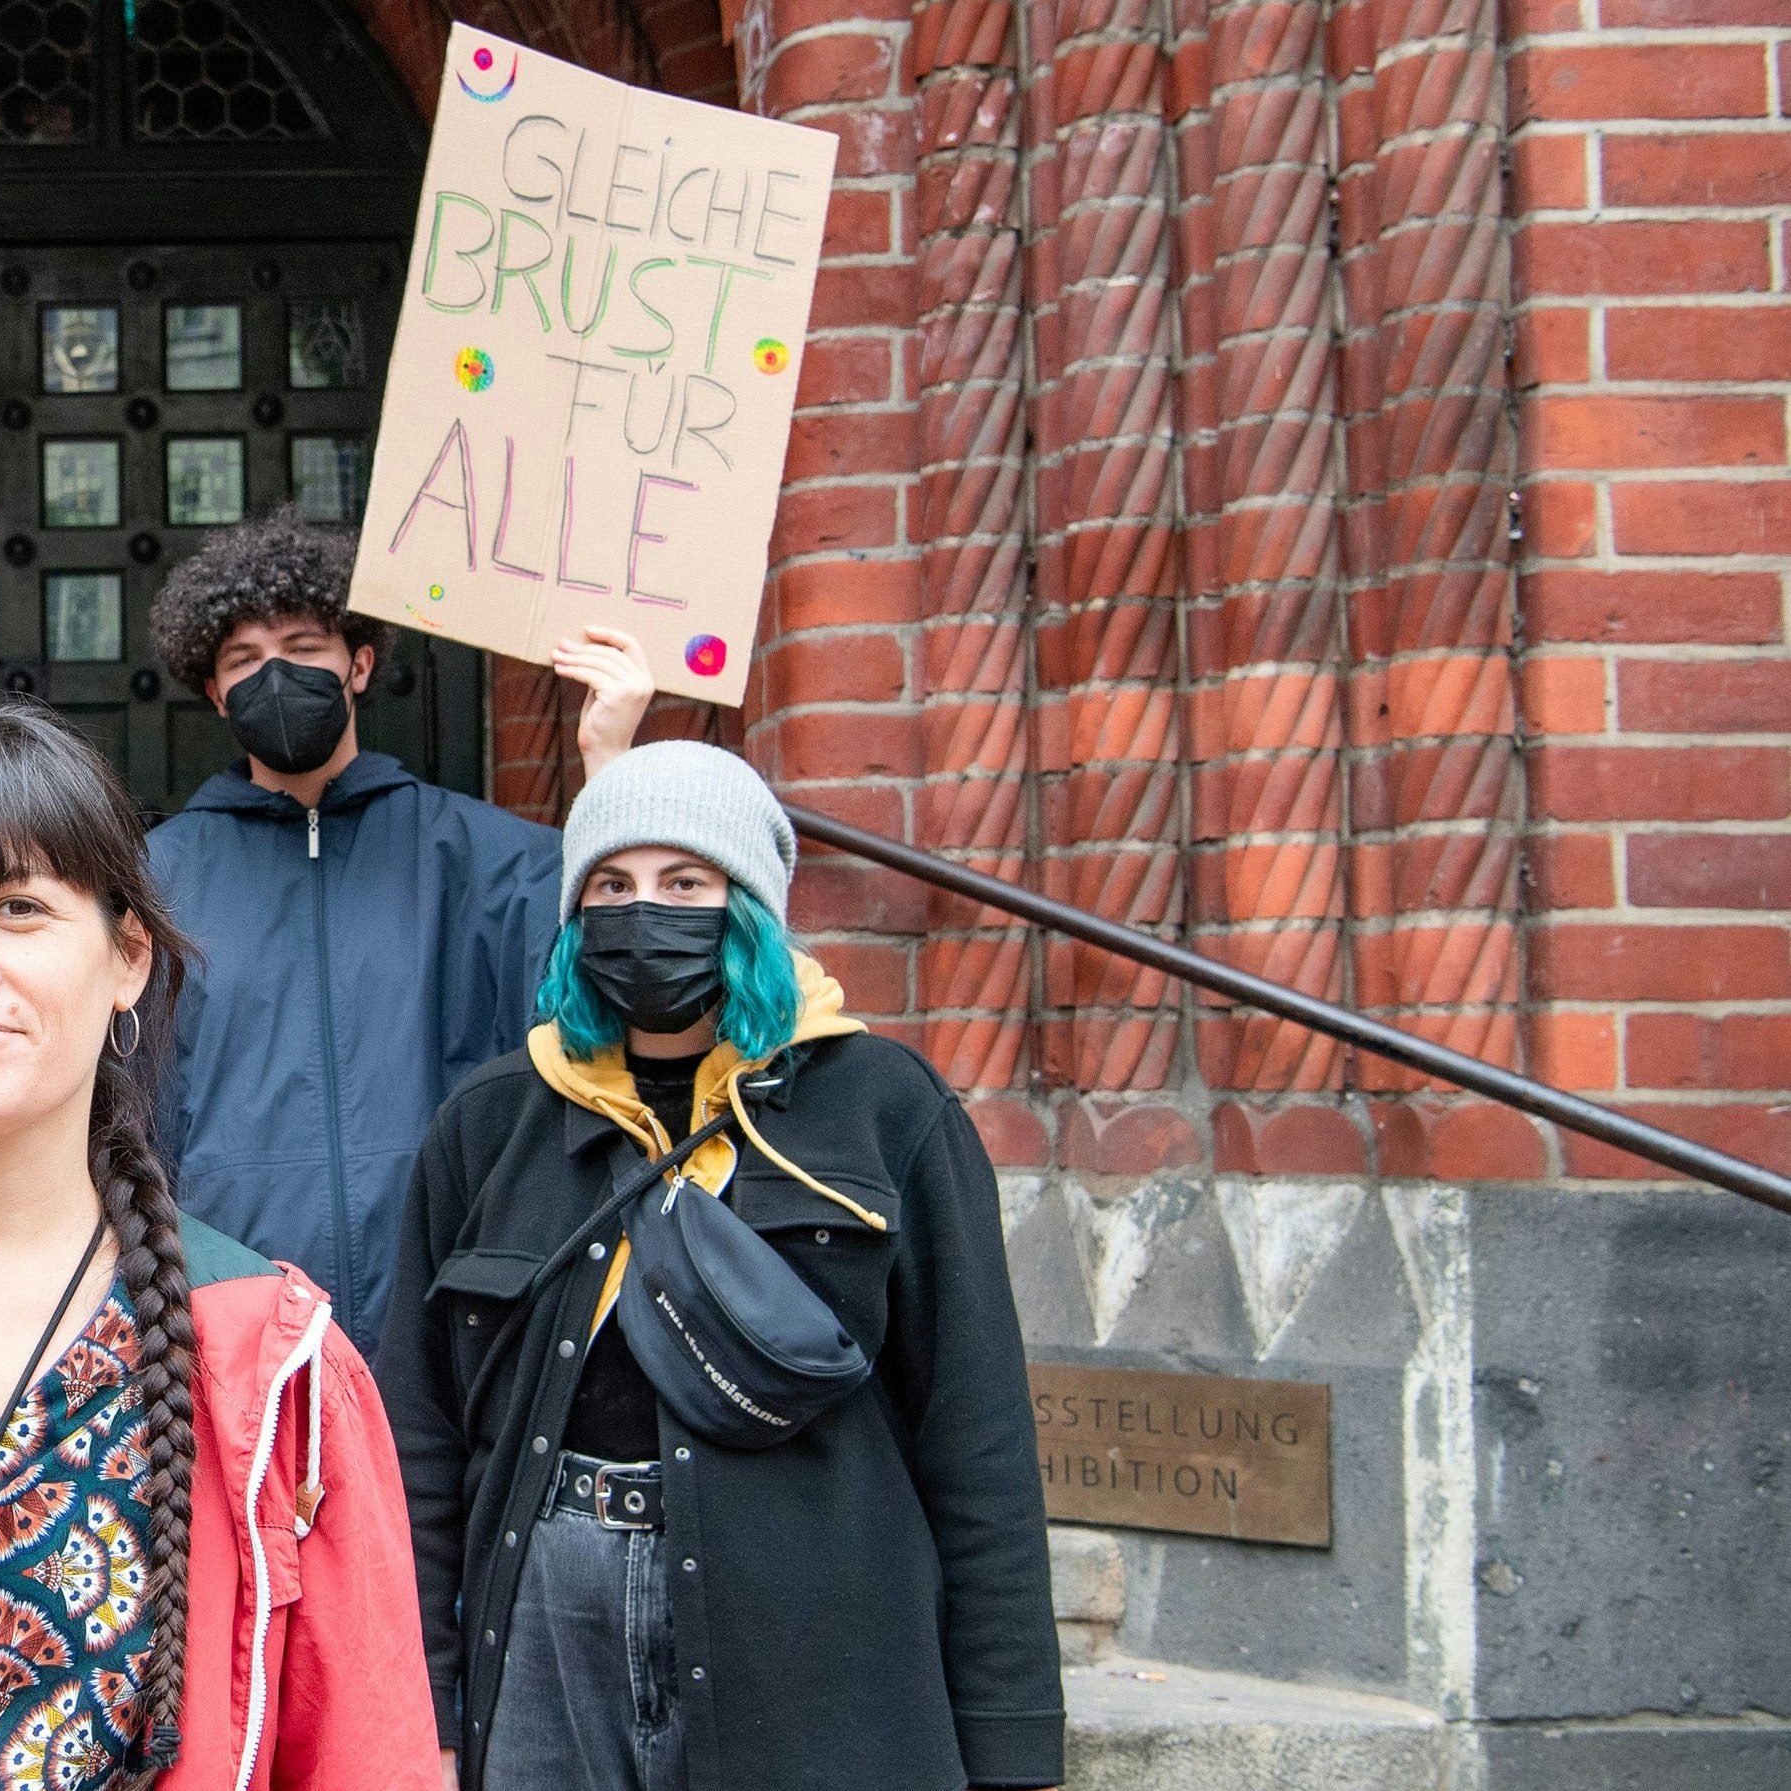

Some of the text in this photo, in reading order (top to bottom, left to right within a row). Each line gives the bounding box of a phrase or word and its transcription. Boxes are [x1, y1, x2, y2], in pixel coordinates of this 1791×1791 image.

[421, 190, 775, 373] BRUST
[545, 353, 735, 472] FÜR
[388, 417, 701, 610] ALLE
[684, 1330, 706, 1363] the
[703, 1361, 793, 1428] resistance
[1034, 1392, 1300, 1446] SSTELLUNG
[1039, 1453, 1239, 1501] HIBITION
